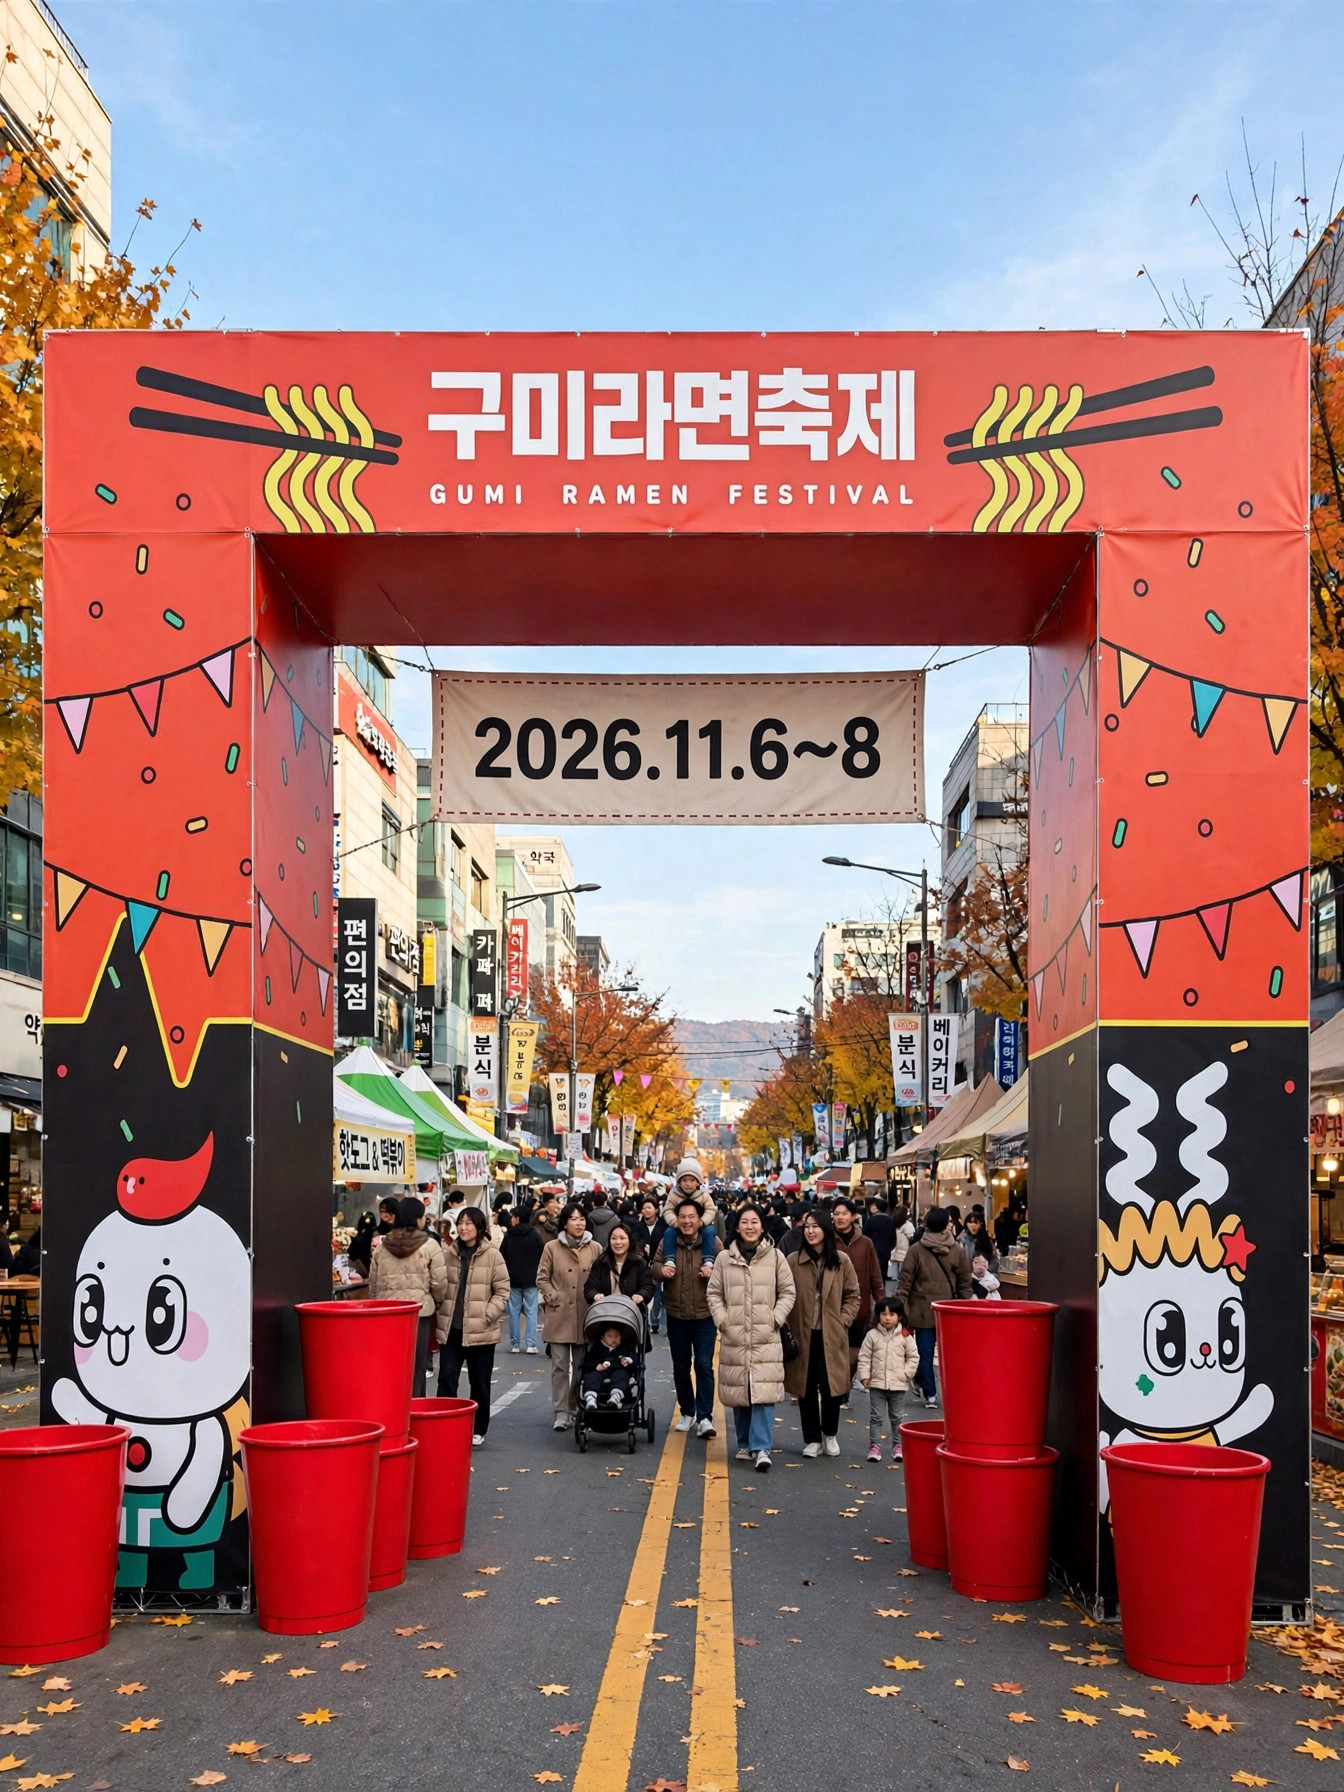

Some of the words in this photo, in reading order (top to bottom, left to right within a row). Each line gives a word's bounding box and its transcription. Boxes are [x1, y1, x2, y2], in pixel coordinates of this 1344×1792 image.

[428, 367, 916, 461] 구미라면축제
[429, 484, 523, 505] GUMI
[562, 484, 689, 505] RAMEN
[729, 484, 915, 505] FESTIVAL
[474, 716, 881, 781] 2026.11.6~8
[343, 919, 367, 1011] 편의점
[473, 1034, 492, 1080] 분식
[897, 1034, 916, 1080] 분식
[931, 1018, 951, 1095] 베이커리
[339, 1129, 371, 1172] 핫도그
[372, 1141, 380, 1172] &
